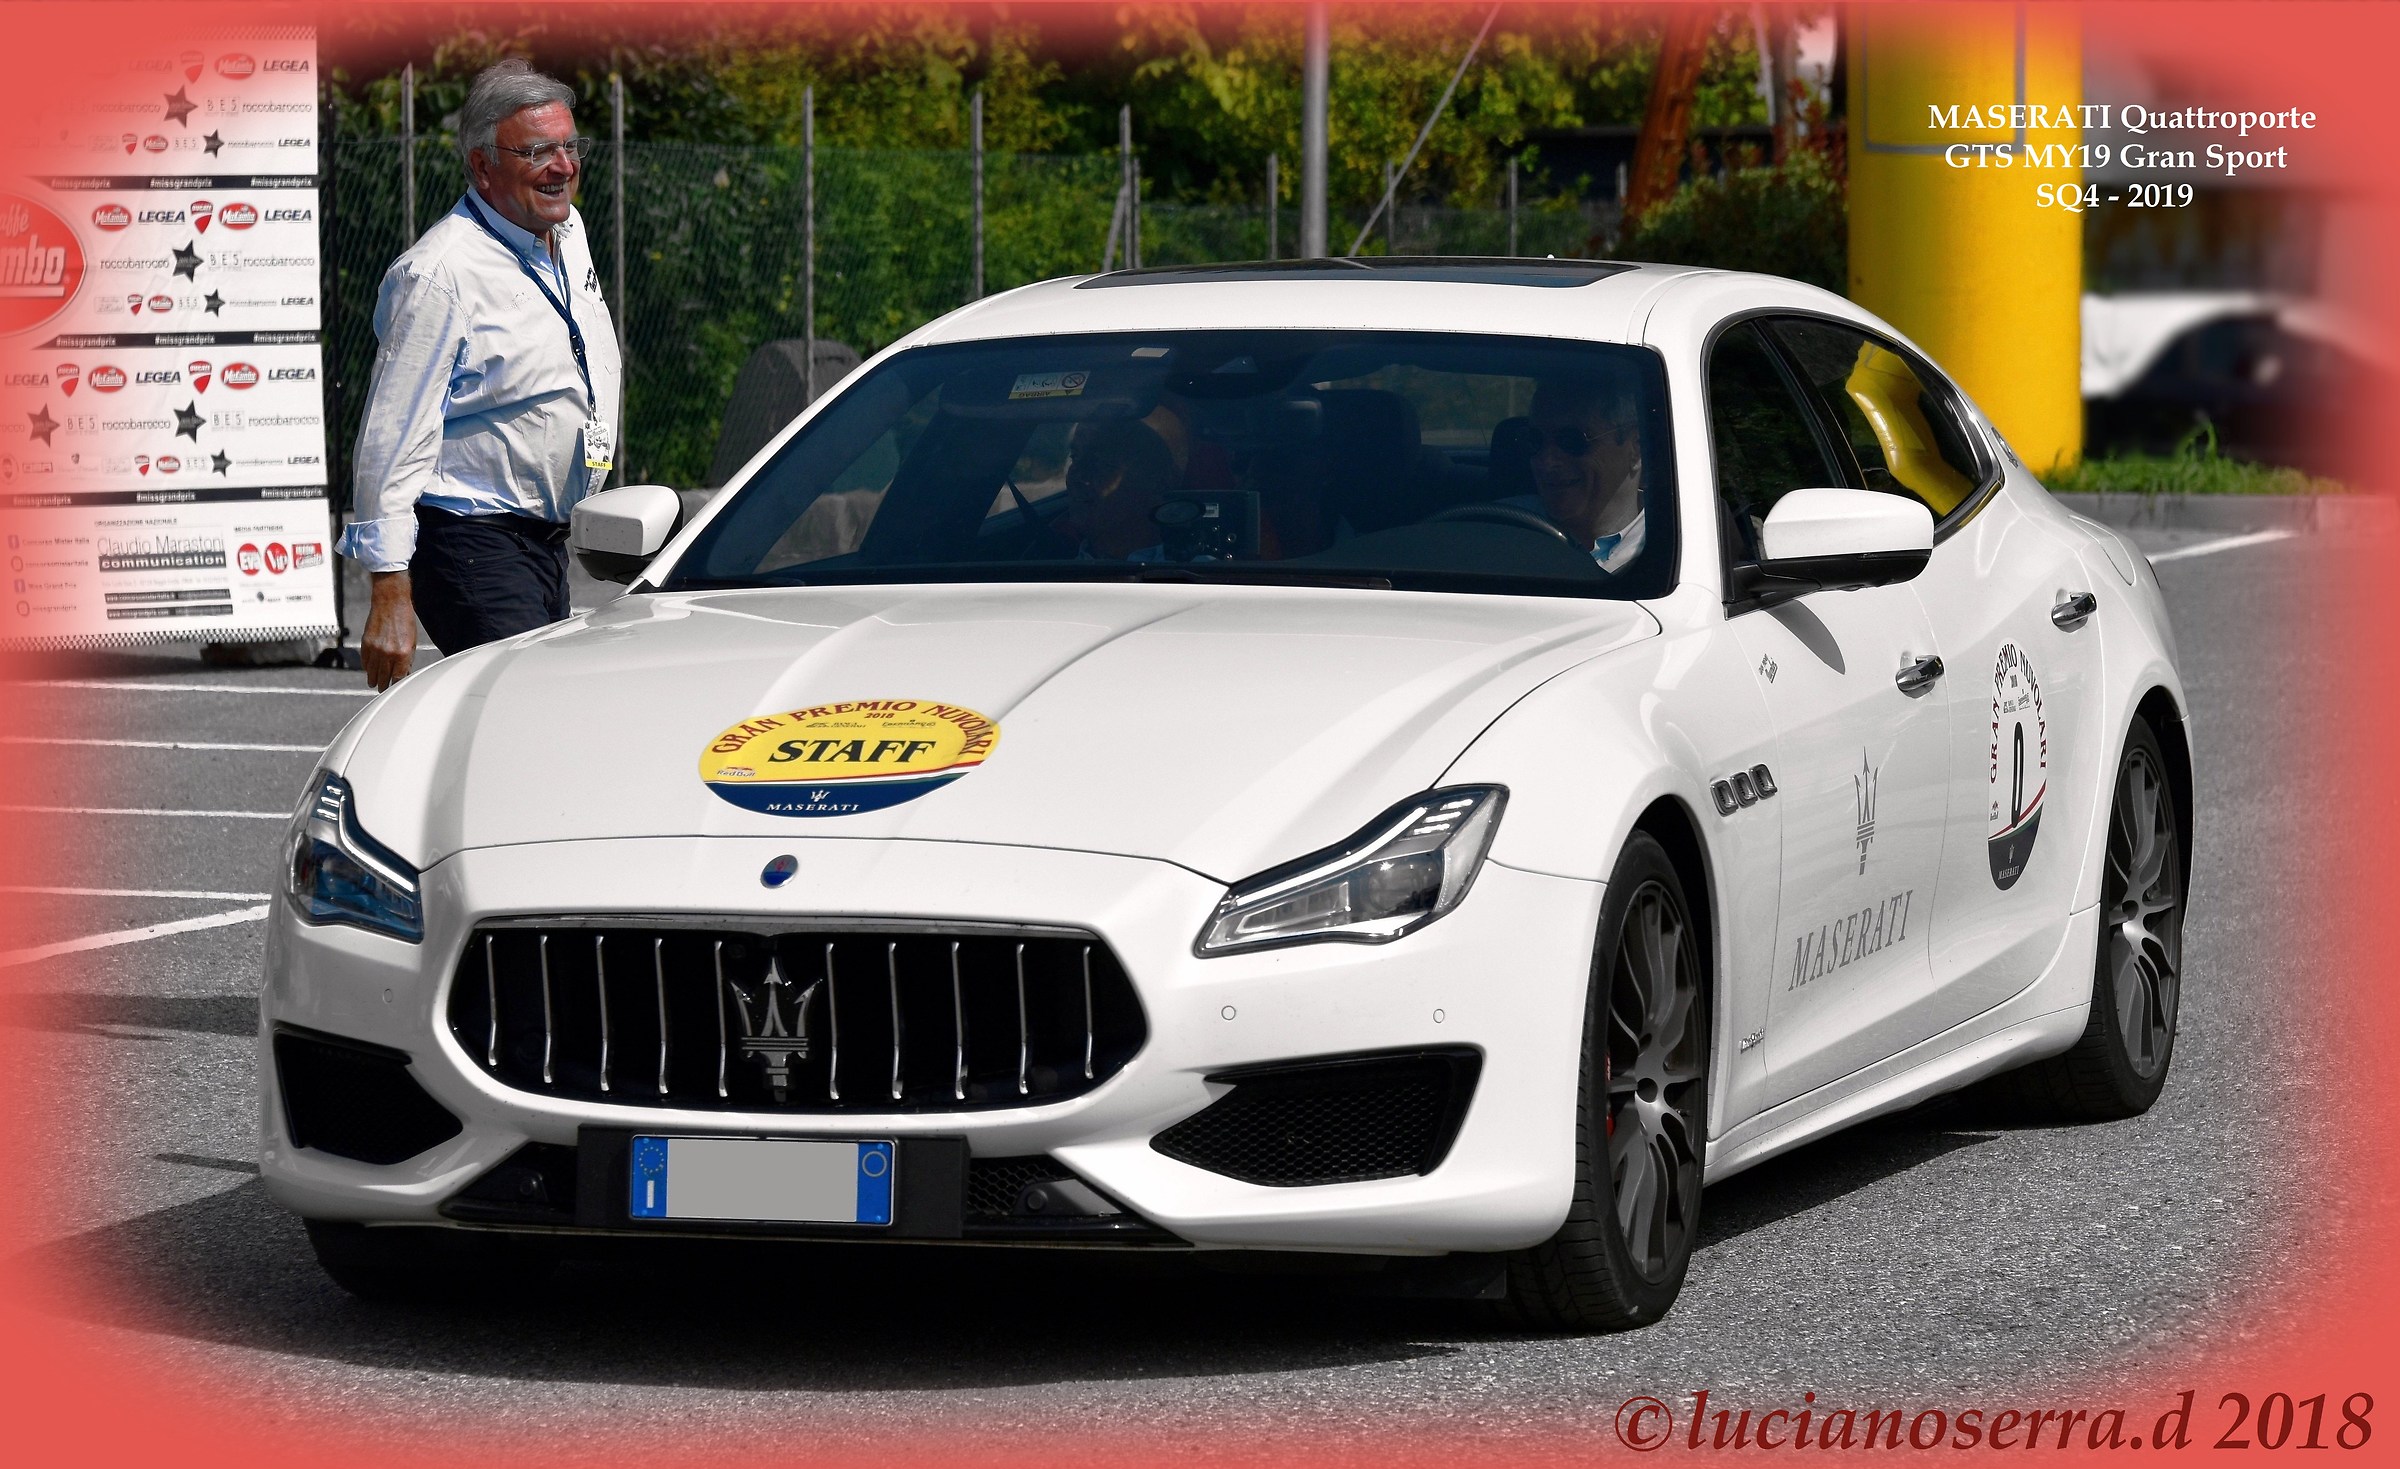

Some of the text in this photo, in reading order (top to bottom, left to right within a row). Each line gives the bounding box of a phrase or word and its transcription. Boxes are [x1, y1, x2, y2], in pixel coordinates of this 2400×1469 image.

[263, 60, 309, 72] LEGEA
[242, 100, 312, 113] roccobarocco
[278, 138, 311, 147] LEGEA
[150, 178, 212, 188] #missgrandprix
[250, 177, 312, 187] #missgrandprix
[138, 211, 185, 223] LEGEA
[264, 209, 312, 222] LEGEA
[100, 256, 169, 269] roccobarocco
[243, 254, 315, 267] roccobarocco
[281, 296, 314, 306] LEGEA
[56, 336, 116, 347] #missgrandprix
[155, 335, 215, 346] #missgrandprix
[253, 332, 316, 343] #missgrandprix
[5, 374, 49, 386] LEGEA
[135, 371, 181, 384] LEGEA
[268, 368, 316, 381] LEGEA
[102, 418, 171, 431] roccobarocco
[248, 412, 319, 426] roccobarocco
[136, 491, 196, 502] #missgrandprix
[260, 487, 323, 498] #missgrandprix
[97, 534, 224, 556] Claudio Marastoni
[101, 555, 224, 569] communication
[1994, 643, 2018, 698] PREMIO
[2019, 649, 2047, 769] NUVOLARI
[865, 712, 895, 720] 2018
[712, 701, 993, 756] GRAN PREMIO NUVOLARI
[768, 739, 936, 763] STAFF
[765, 803, 860, 812] MASERATI
[1998, 865, 2020, 880] MASERATI
[1788, 890, 1914, 992] MASERATI
